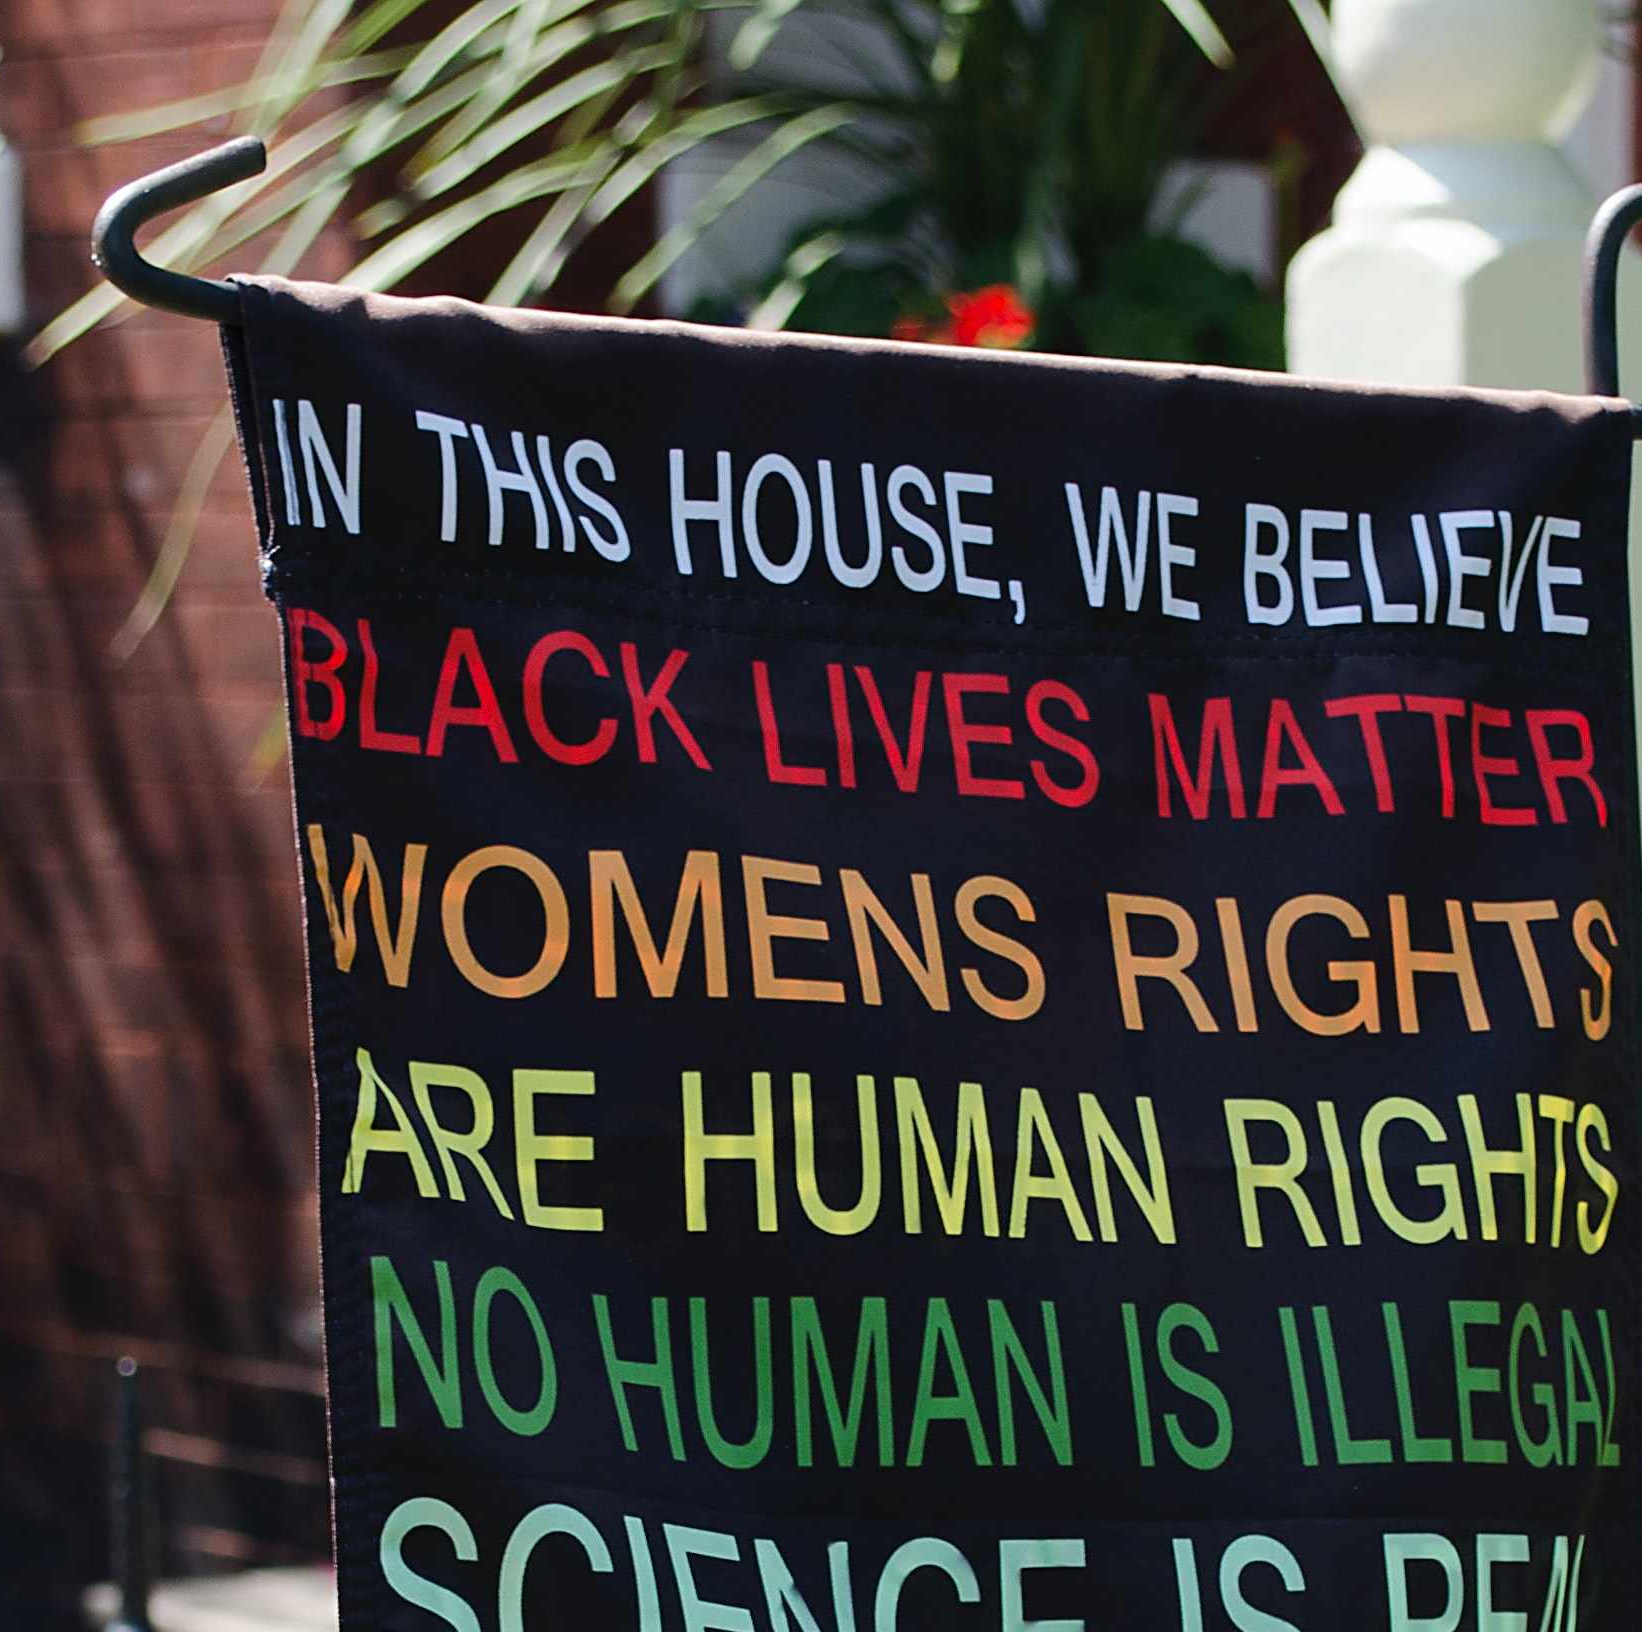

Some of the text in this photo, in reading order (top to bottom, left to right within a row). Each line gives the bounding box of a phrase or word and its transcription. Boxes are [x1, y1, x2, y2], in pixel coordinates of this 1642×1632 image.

[273, 399, 1589, 635] IN THIS HOUSE, WE BELIEVE
[286, 607, 1607, 827] BLACK LIVES MATTER
[306, 824, 1618, 1040] WOMENS RIGHTS
[342, 1048, 1618, 1254] ARE HUMAN RIGHTS
[371, 1256, 1620, 1469] NO HUMAN IS ILLEGAL
